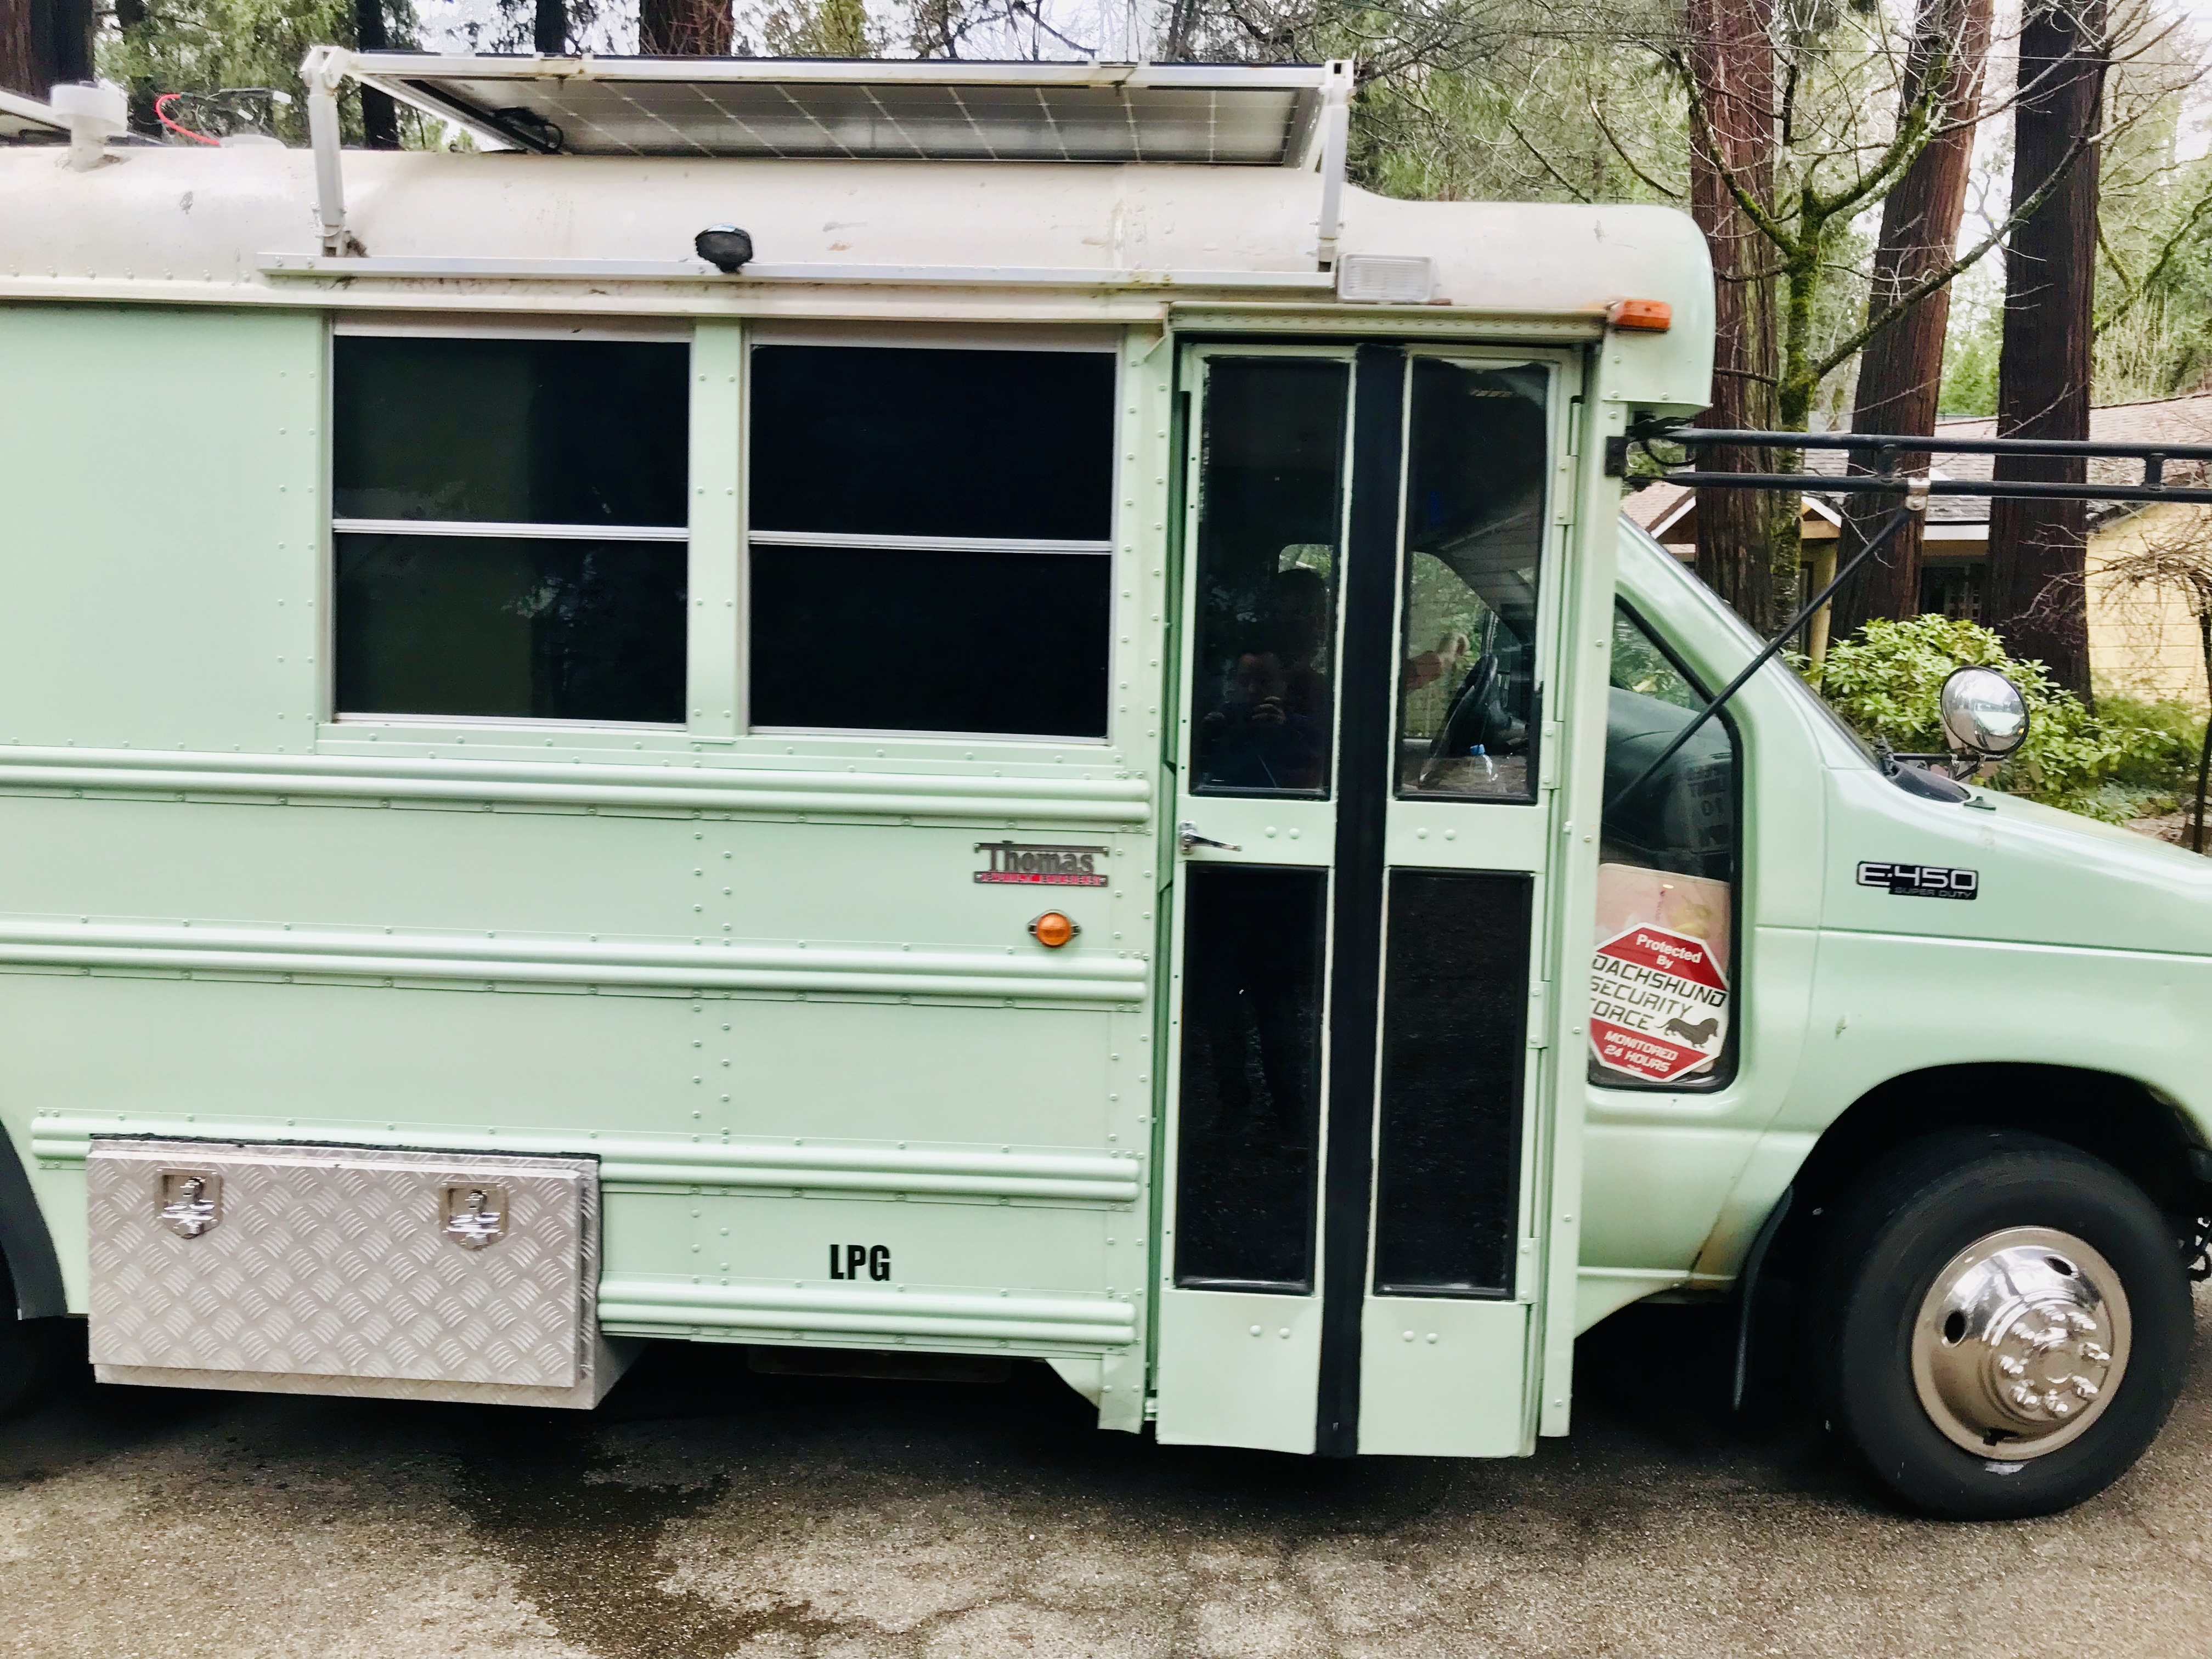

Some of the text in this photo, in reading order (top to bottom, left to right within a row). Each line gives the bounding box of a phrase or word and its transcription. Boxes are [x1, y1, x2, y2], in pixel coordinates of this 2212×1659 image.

[974, 840, 1108, 874] Thomas
[1859, 863, 1976, 890] E-450
[1894, 887, 1972, 899] SUPER DUTY
[1636, 933, 1702, 964] Protected
[1656, 954, 1673, 969] By
[1592, 955, 1726, 1008] DACHSHUND
[1590, 997, 1655, 1031] ORCE
[1604, 1030, 1679, 1061] MONITORED
[1604, 1045, 1672, 1073] 24 HOURS
[830, 1244, 890, 1281] LPG
